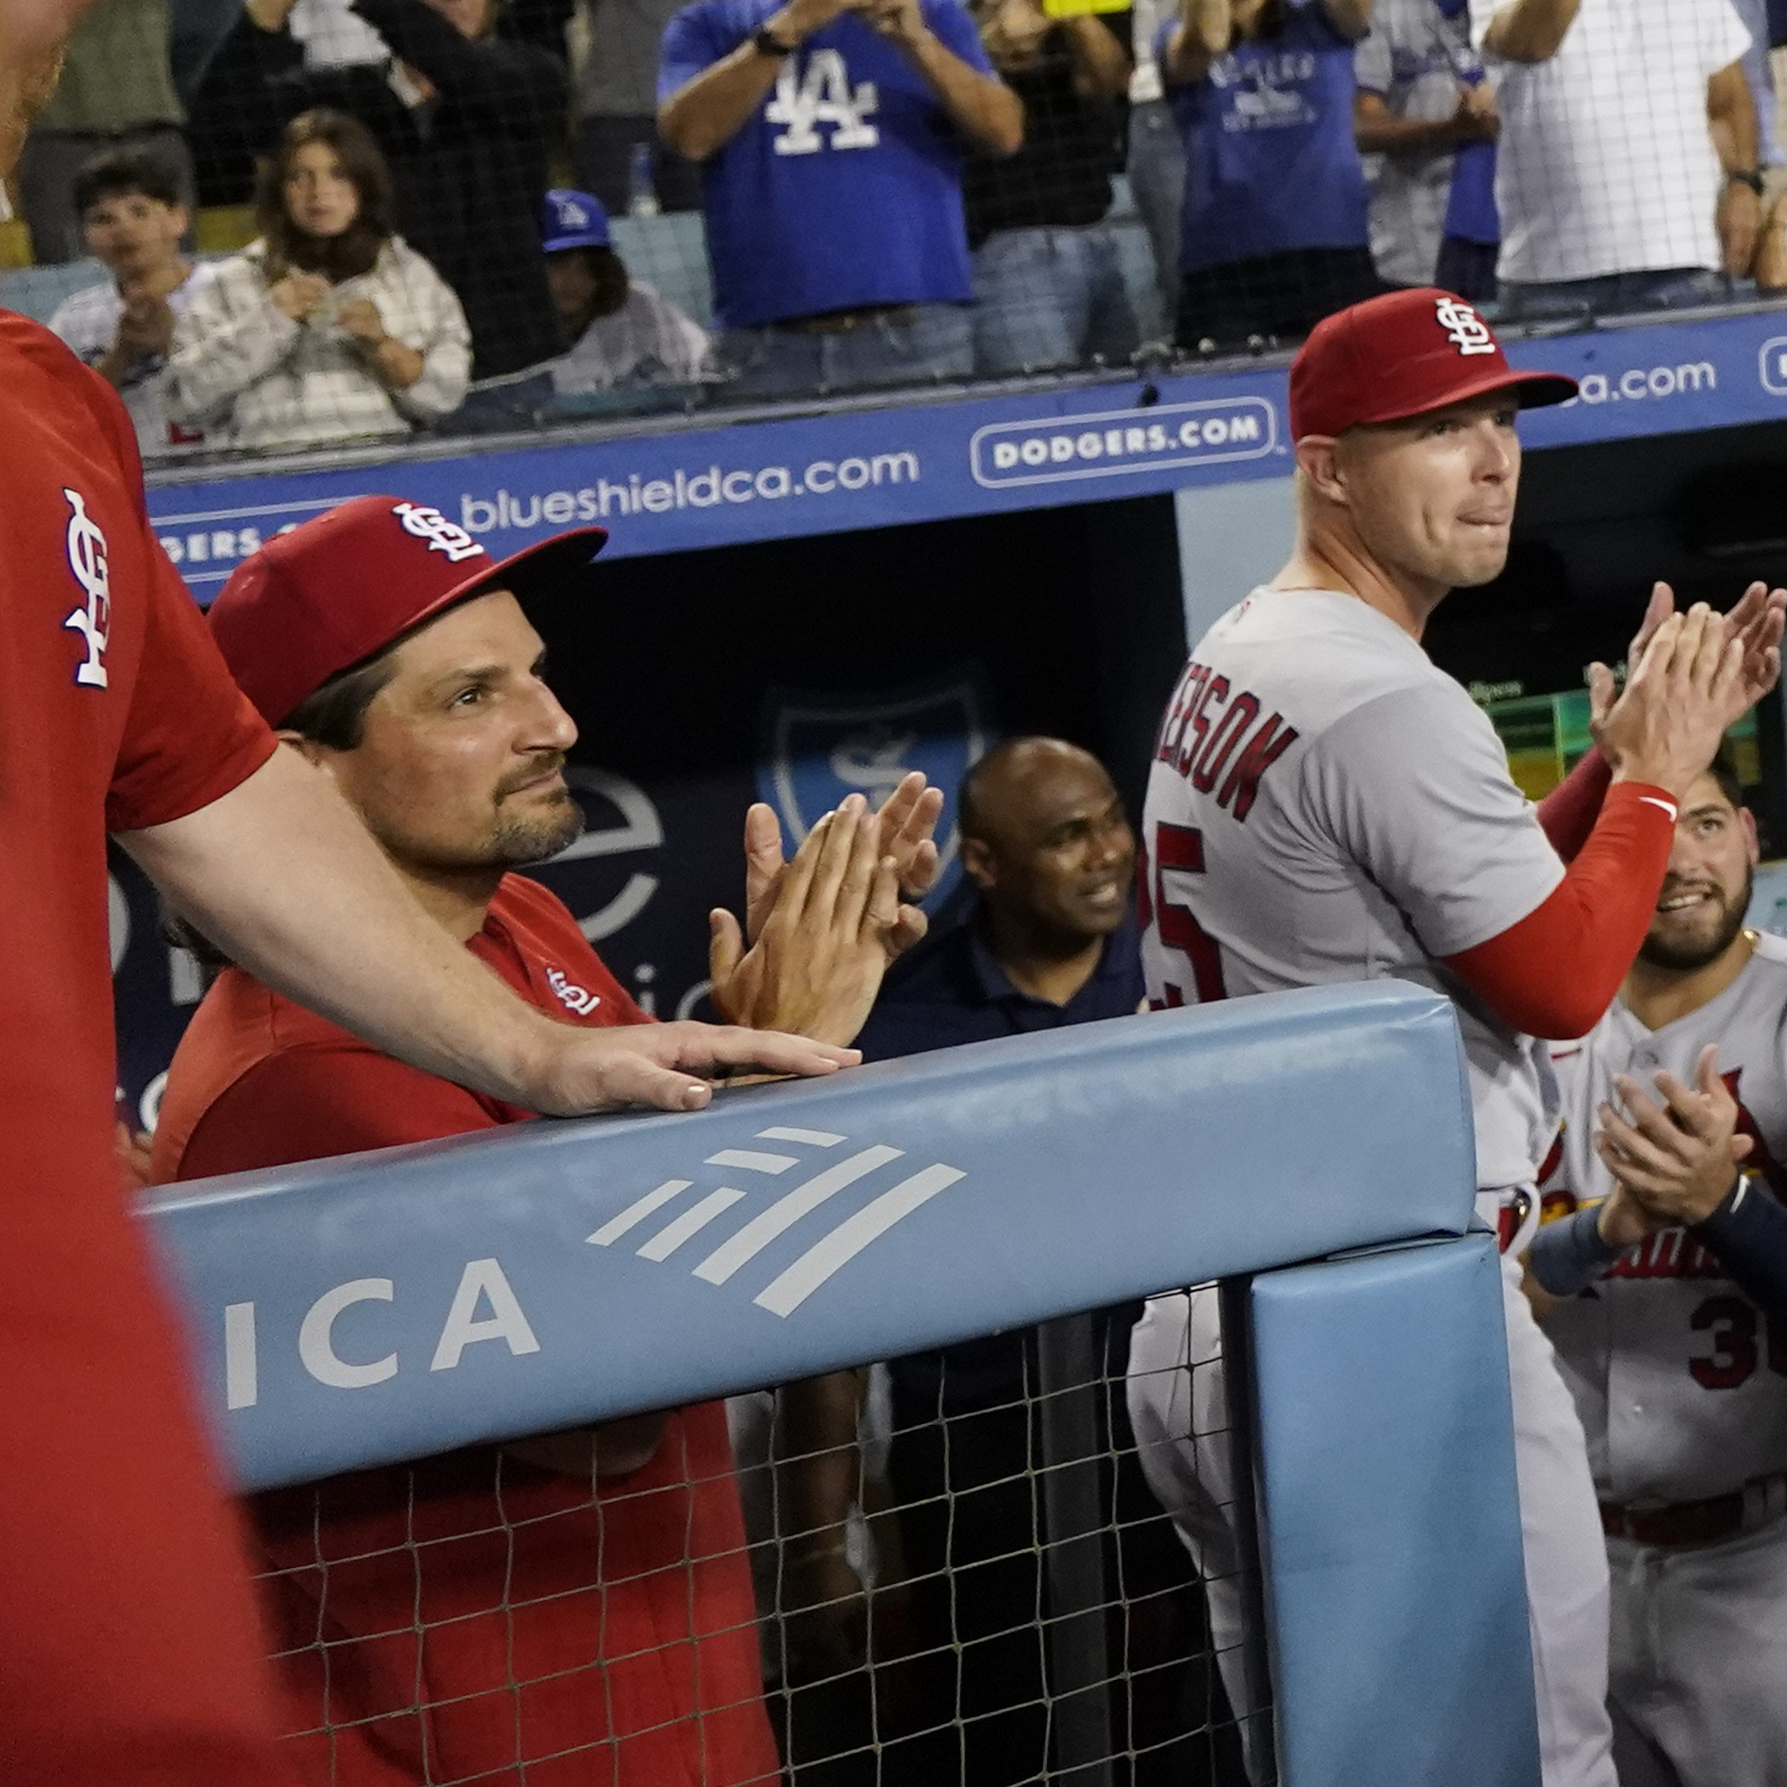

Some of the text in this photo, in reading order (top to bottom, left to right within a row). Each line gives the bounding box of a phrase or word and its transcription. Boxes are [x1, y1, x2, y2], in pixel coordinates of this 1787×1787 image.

[763, 48, 880, 156] LA
[463, 446, 920, 533] blueshieldca.com
[993, 415, 1260, 469] DODGERS.COM
[1139, 820, 1229, 1012] 5
[224, 1257, 541, 1411] ICA
